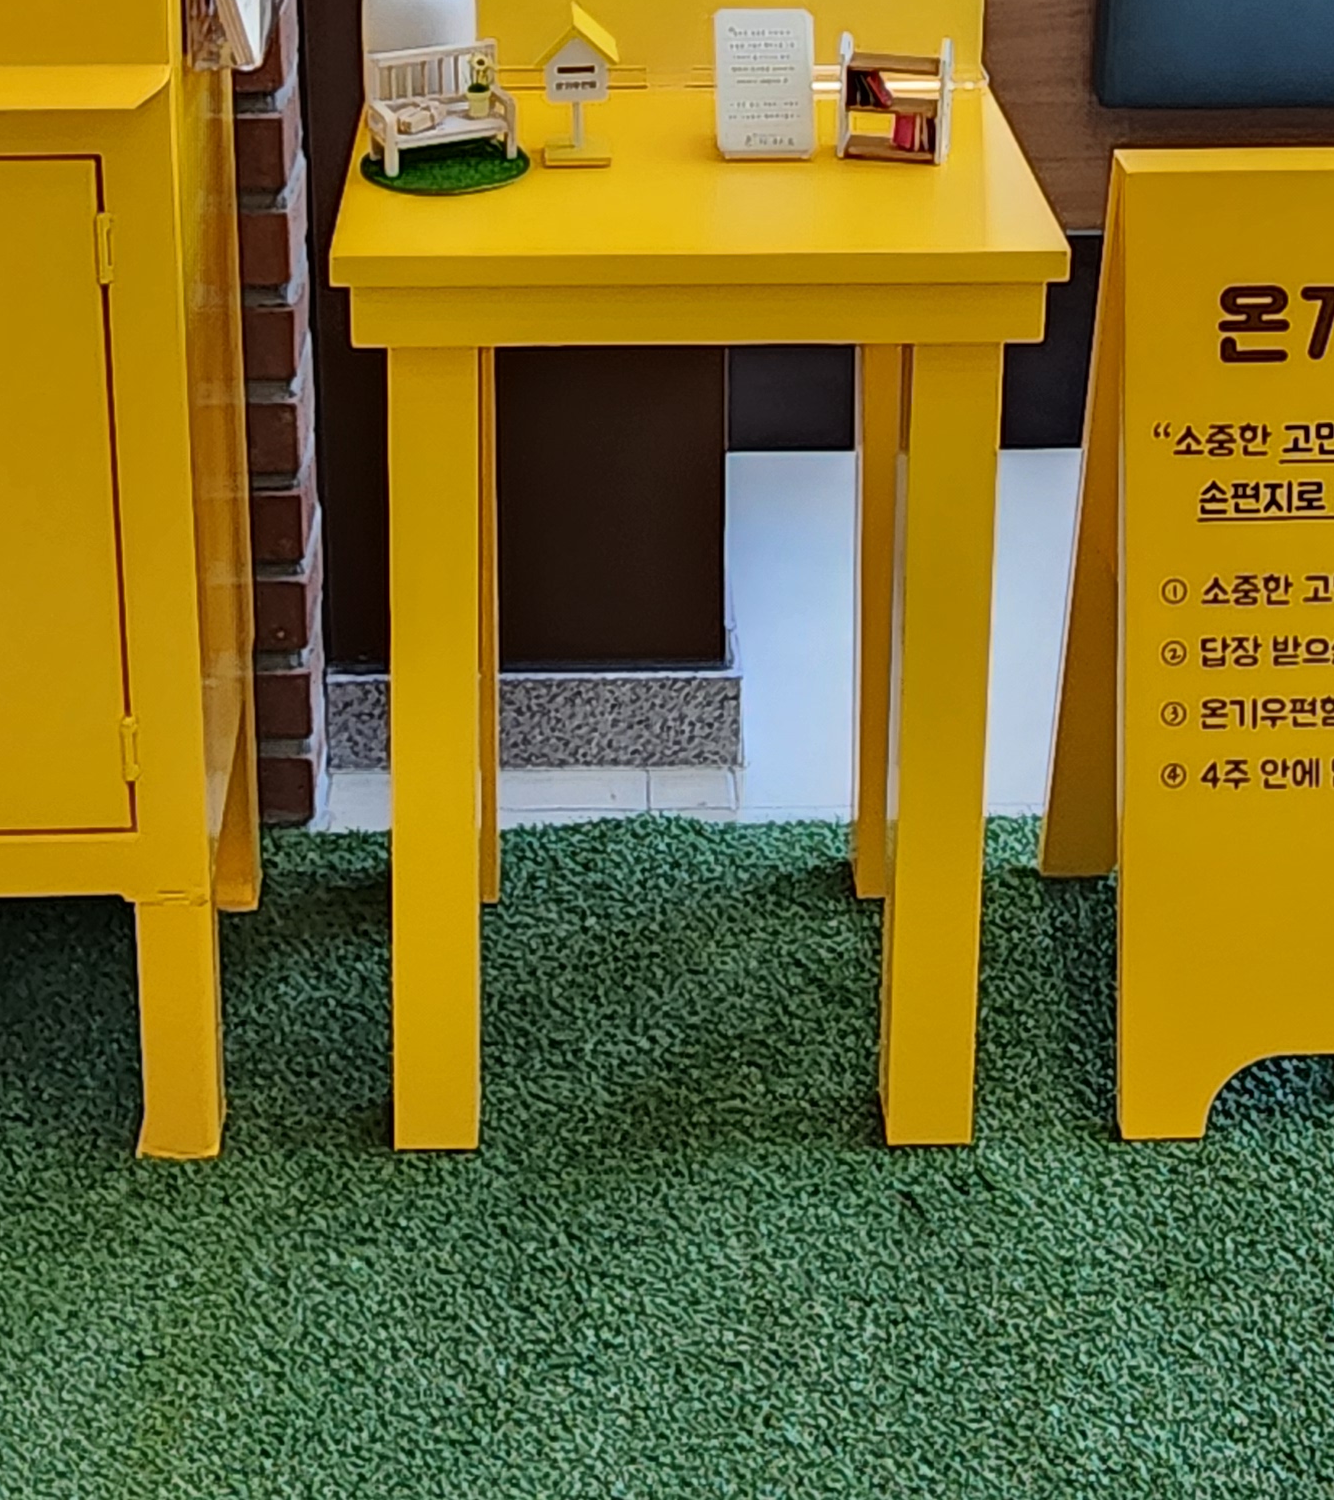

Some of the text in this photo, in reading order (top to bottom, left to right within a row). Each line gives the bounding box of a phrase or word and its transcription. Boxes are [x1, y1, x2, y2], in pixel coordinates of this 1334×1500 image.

[1198, 479, 1327, 514] 손편지로
[1200, 573, 1293, 607] 소중한
[1199, 634, 1261, 669] 답장
[1200, 758, 1251, 789] 4주
[1260, 757, 1320, 789] 안에
